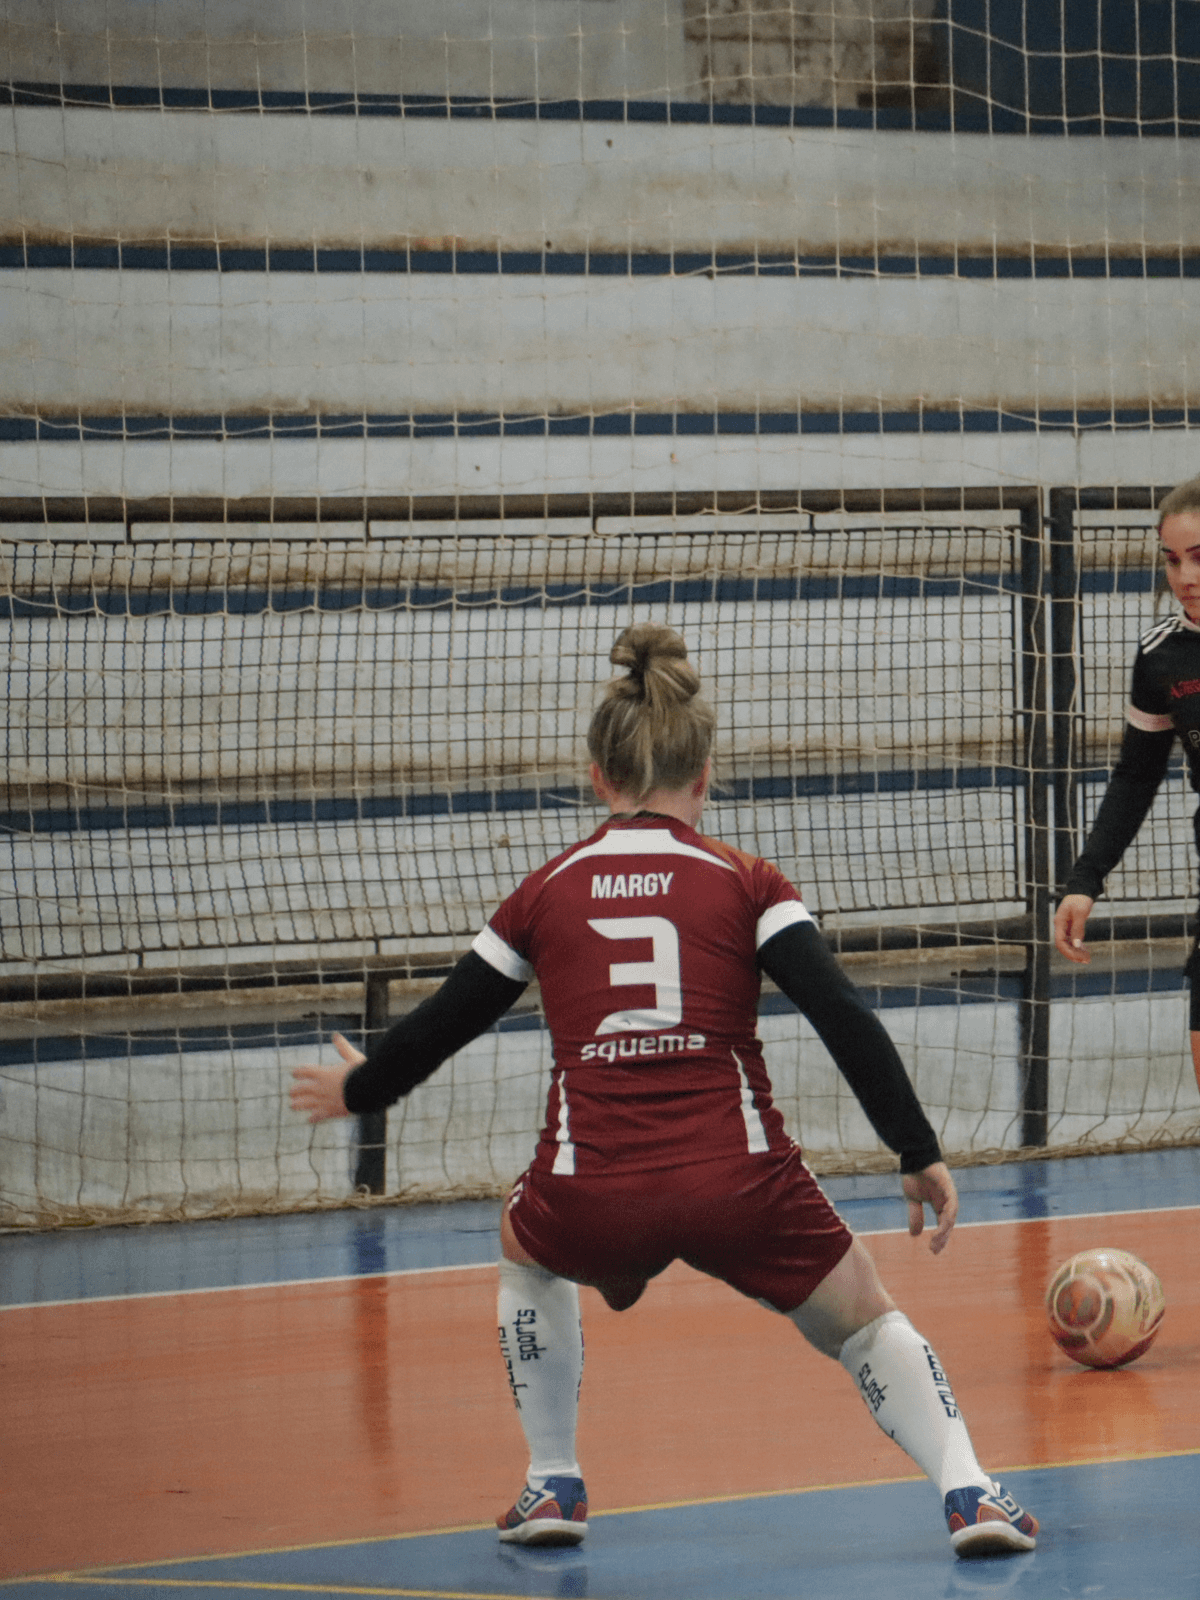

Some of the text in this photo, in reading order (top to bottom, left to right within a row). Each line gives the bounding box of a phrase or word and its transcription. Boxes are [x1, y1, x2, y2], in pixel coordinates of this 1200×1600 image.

[591, 872, 674, 899] MARGY
[587, 916, 683, 1036] 3
[580, 1033, 706, 1063] squema
[512, 1309, 547, 1361] sports
[858, 1362, 888, 1413] sports
